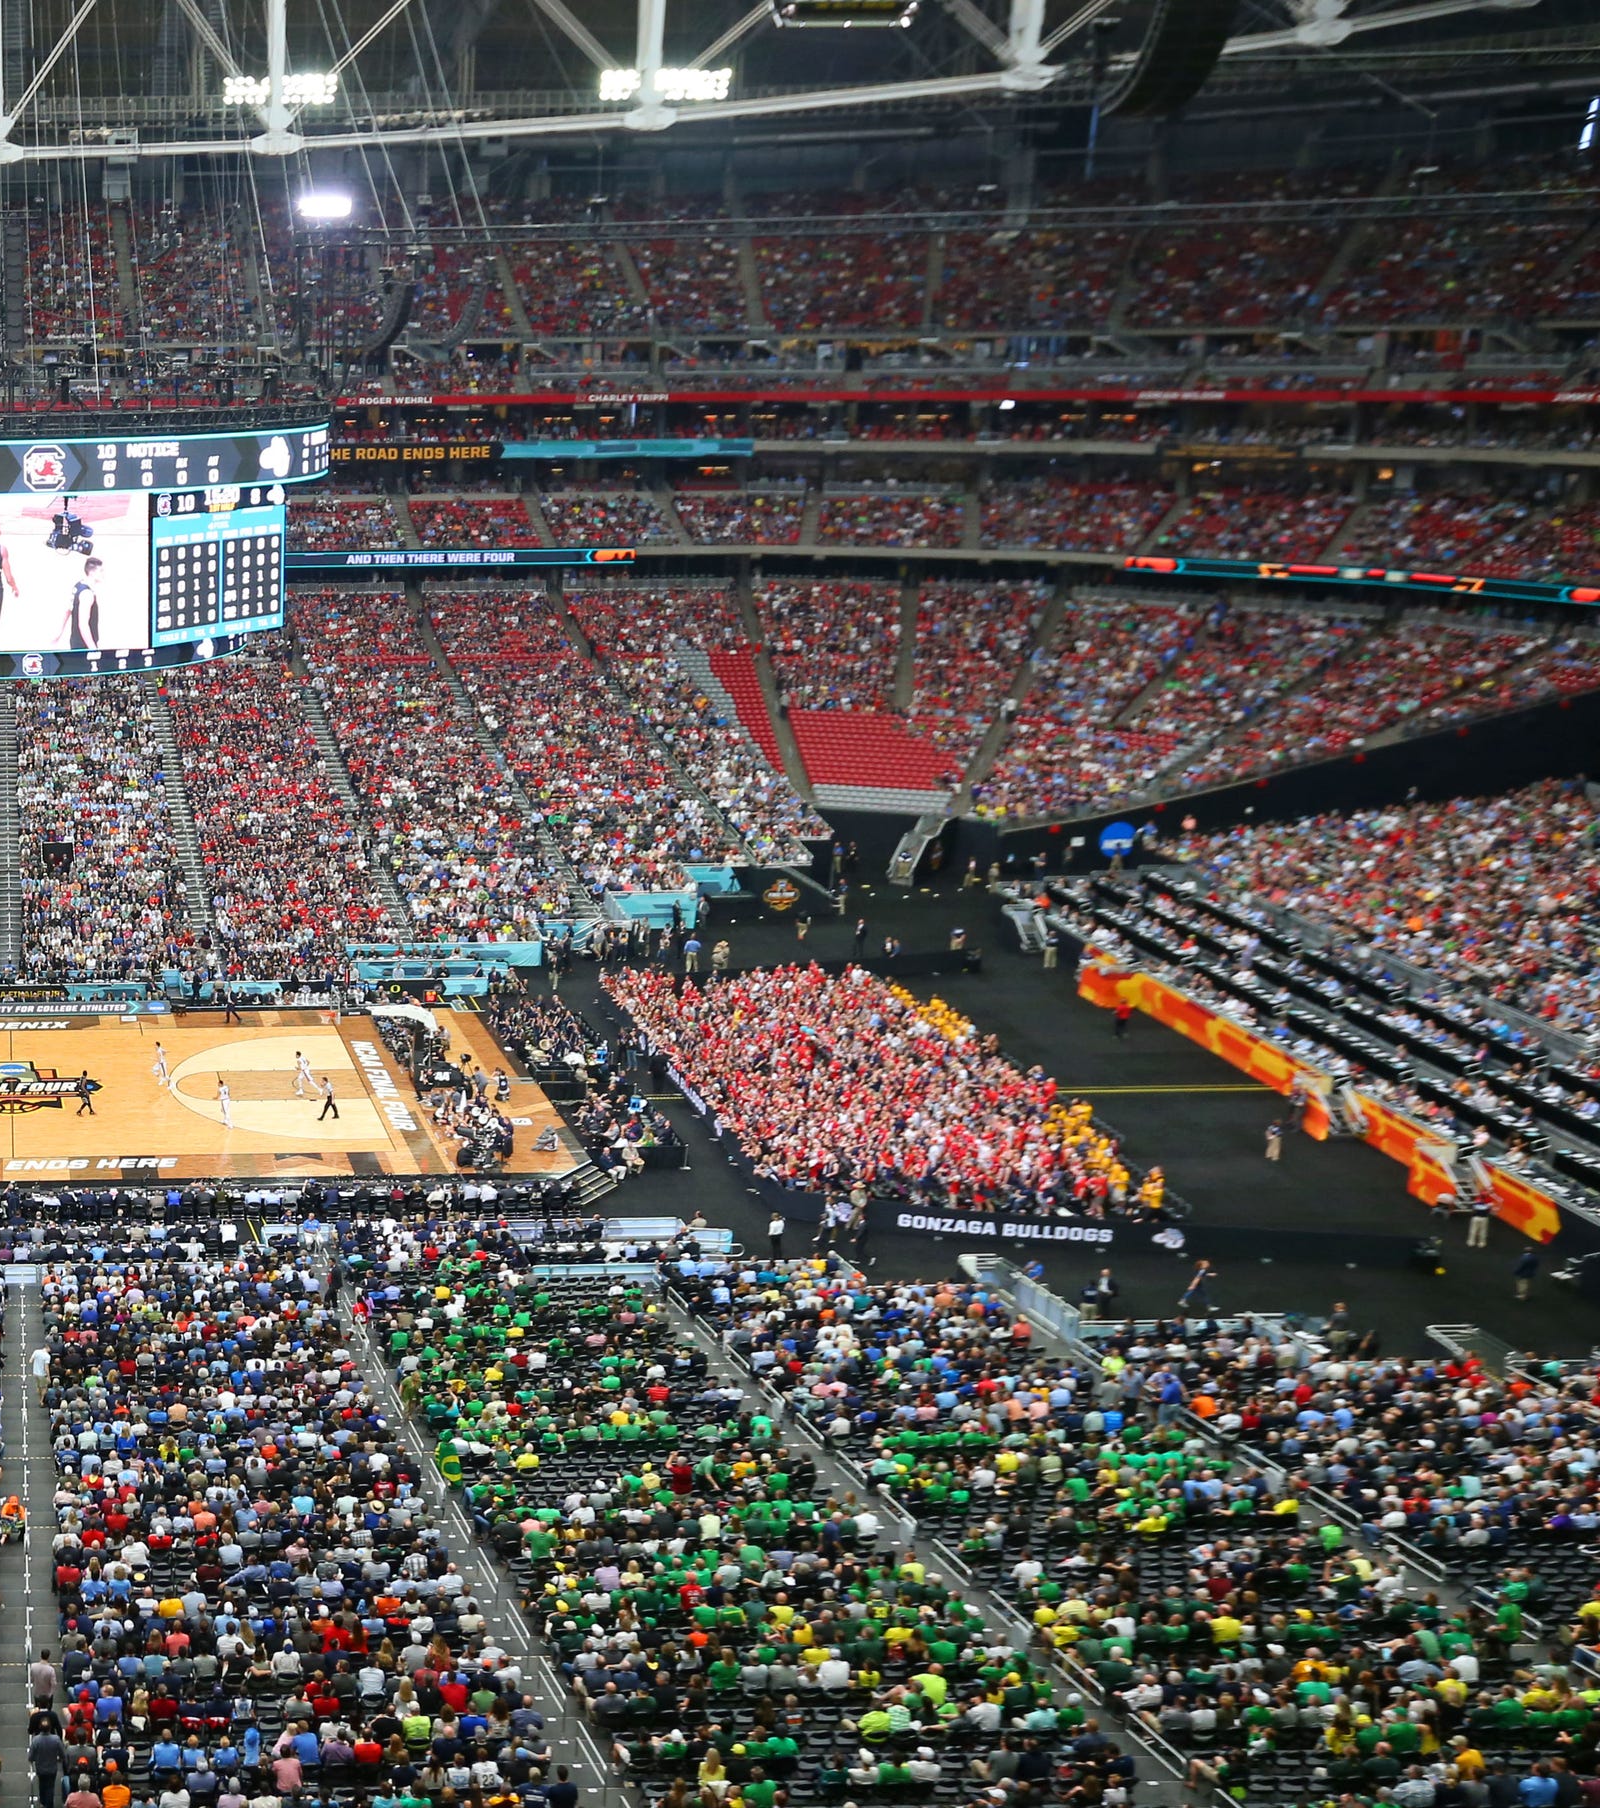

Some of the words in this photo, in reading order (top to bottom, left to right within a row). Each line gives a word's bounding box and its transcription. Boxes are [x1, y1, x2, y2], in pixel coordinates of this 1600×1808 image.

[359, 397, 392, 405] ROGER
[394, 396, 433, 404] WEHRLI
[97, 444, 116, 459] 10
[126, 442, 180, 458] NOTICE
[356, 447, 398, 460] ROAD
[403, 447, 445, 459] ENDS
[450, 445, 490, 458] HERE
[103, 473, 115, 488] 0
[142, 472, 153, 487] 0
[177, 471, 187, 485] 0
[209, 468, 219, 483] 0
[177, 494, 195, 512] 10
[250, 488, 261, 505] 8
[346, 554, 371, 565] AND
[373, 554, 405, 564] THEN
[407, 553, 445, 564] THERE
[446, 553, 481, 563] WERE
[483, 552, 515, 562] FOUR
[15, 1004, 34, 1013] FOR
[37, 1004, 78, 1013] COLLEGE
[80, 1003, 127, 1012] ATHLETES
[350, 1040, 384, 1067] NCAA
[15, 1081, 78, 1093] FOUR
[363, 1068, 401, 1099] FINAL
[380, 1100, 418, 1131] FOUR
[4, 1159, 90, 1172] ENDS
[95, 1157, 179, 1170] HERE
[896, 1213, 997, 1236] GONZAGA
[1001, 1221, 1115, 1243] BULLDOGS
[482, 1774, 495, 1786] 23
